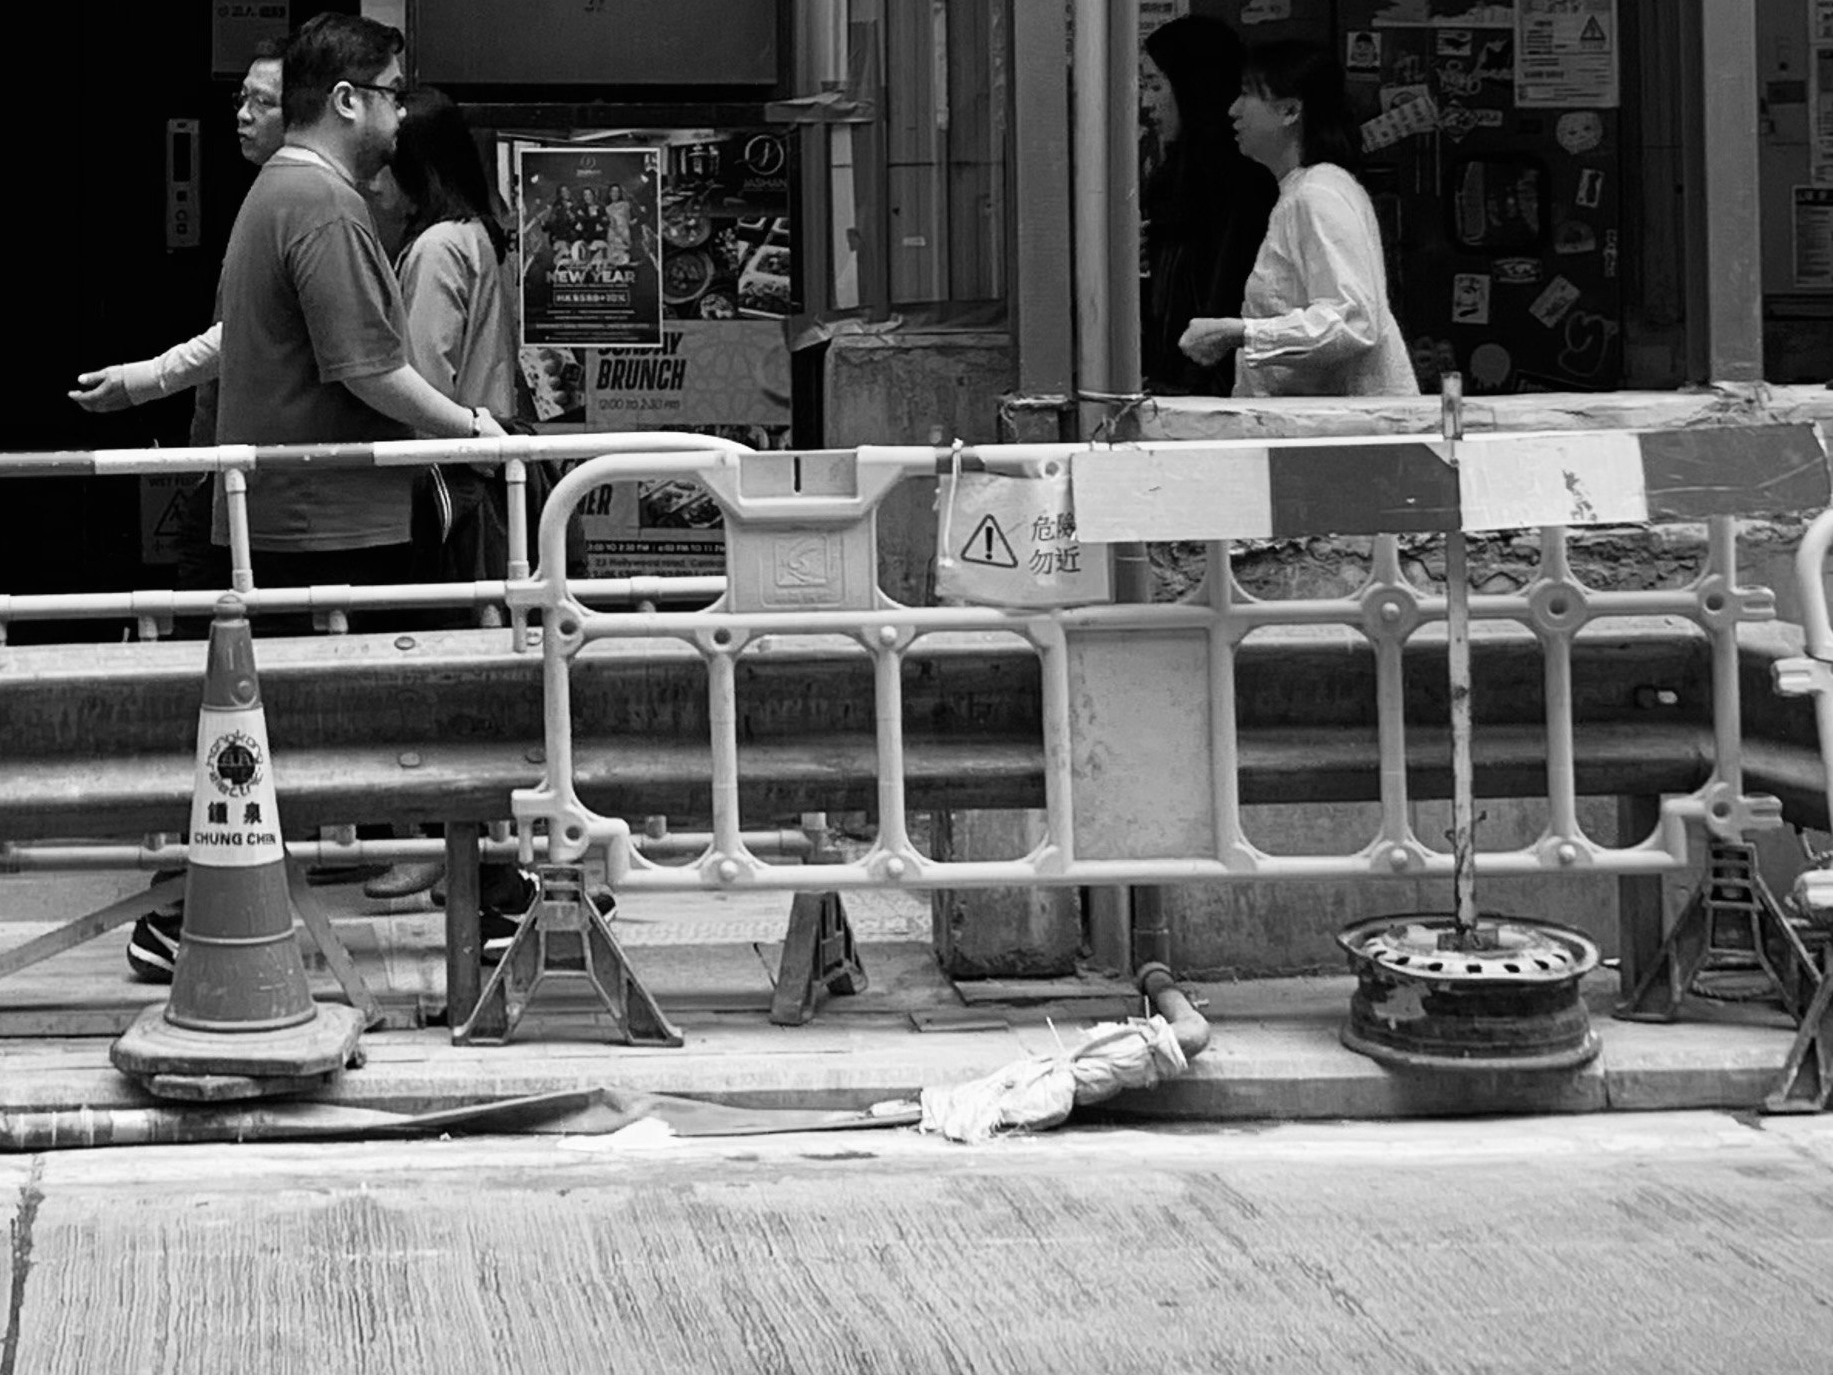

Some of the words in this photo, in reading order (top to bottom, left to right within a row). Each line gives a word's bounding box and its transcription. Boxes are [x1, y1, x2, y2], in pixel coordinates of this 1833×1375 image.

[545, 270, 585, 284] NEW
[592, 270, 636, 284] YEAR
[596, 359, 686, 391] BRUNCH
[1030, 546, 1081, 575] 勿近
[194, 832, 243, 846] CHUNG
